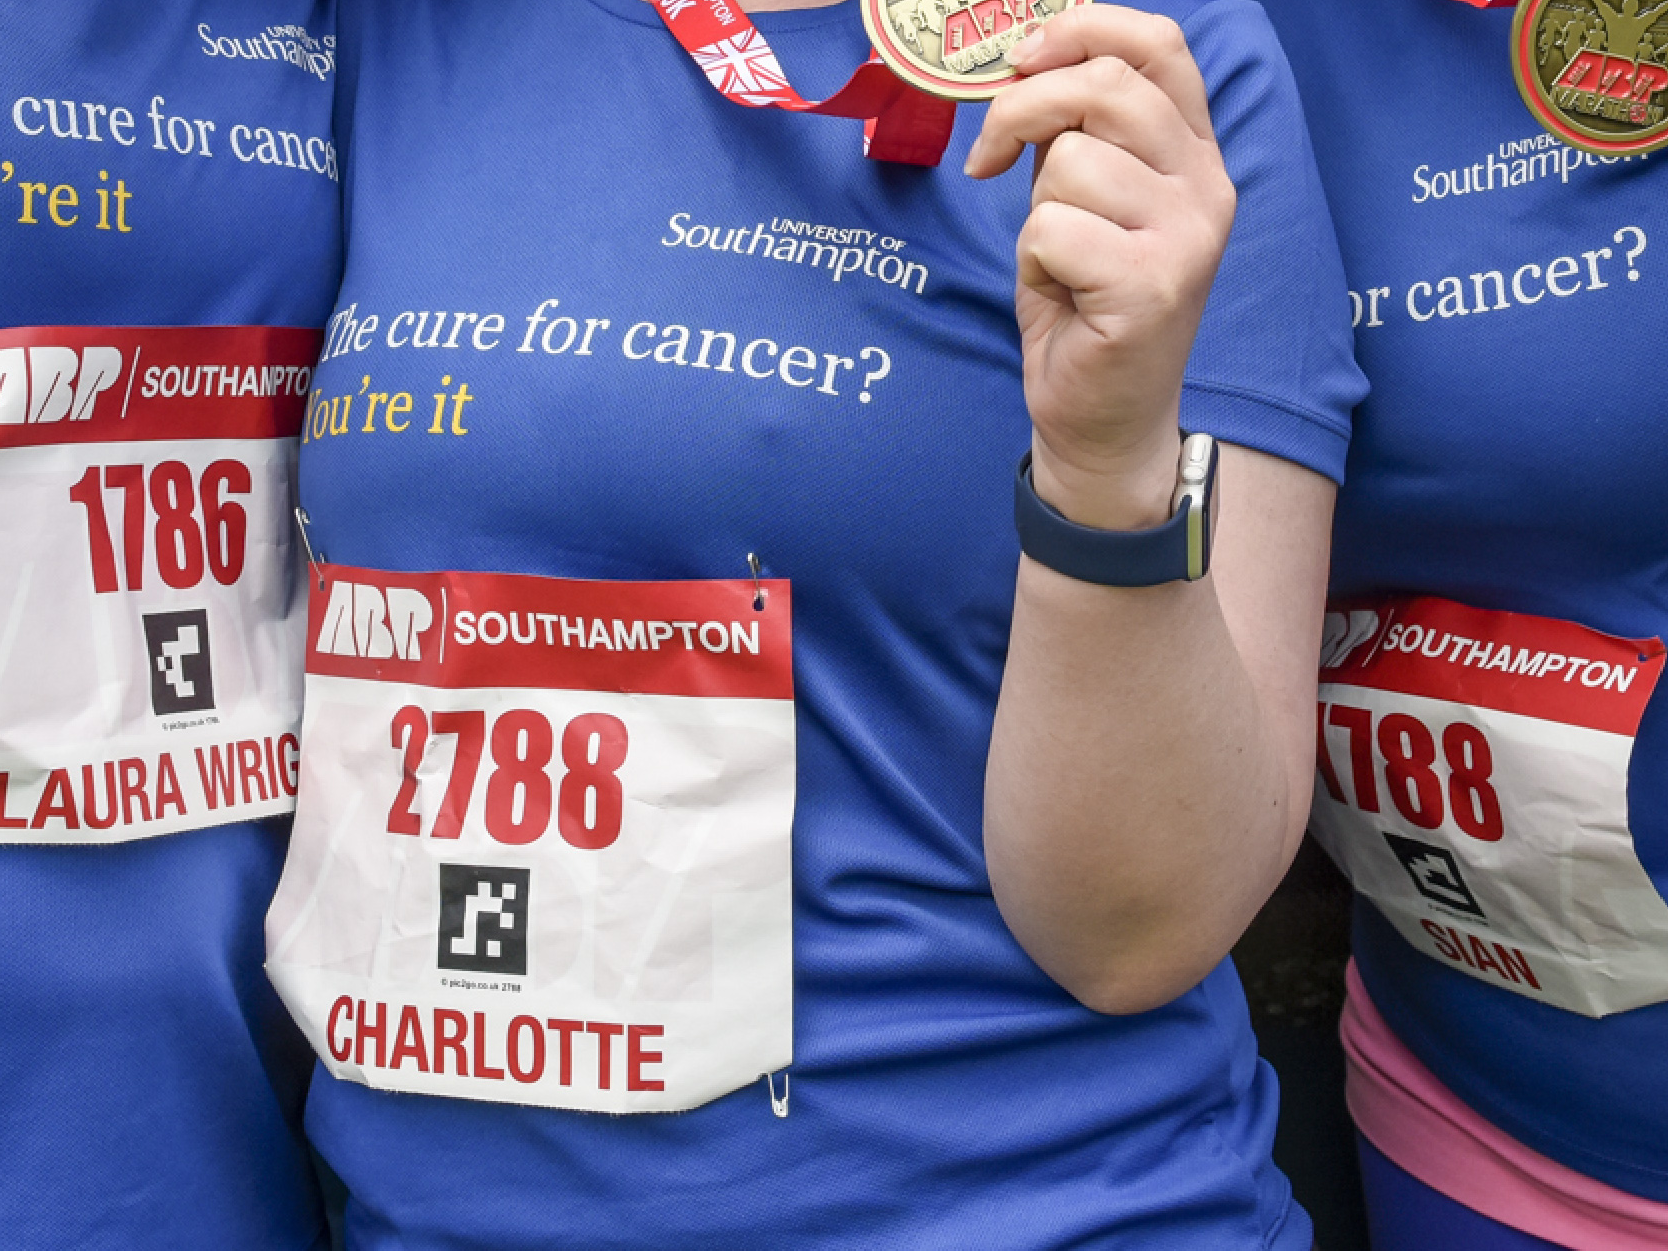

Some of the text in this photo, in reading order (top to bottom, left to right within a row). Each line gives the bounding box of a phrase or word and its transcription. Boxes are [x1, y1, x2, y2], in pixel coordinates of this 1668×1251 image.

[11, 94, 137, 147] cure
[147, 95, 216, 158] for
[94, 170, 133, 233] it
[770, 216, 908, 252] UNIVERSITY OF
[660, 212, 929, 295] Southampton
[1406, 226, 1648, 322] cancer?
[385, 305, 507, 353] cure
[516, 298, 610, 356] for
[622, 319, 892, 405] cancer?
[427, 373, 474, 437] it
[69, 458, 253, 594] 1786
[314, 580, 761, 662] ABP SOUTHAMPTON
[1382, 623, 1638, 694] SOUTHAMPTON
[386, 703, 629, 850] 2788
[1419, 918, 1542, 991] SIAN
[326, 994, 665, 1093] CHARLOTTE
